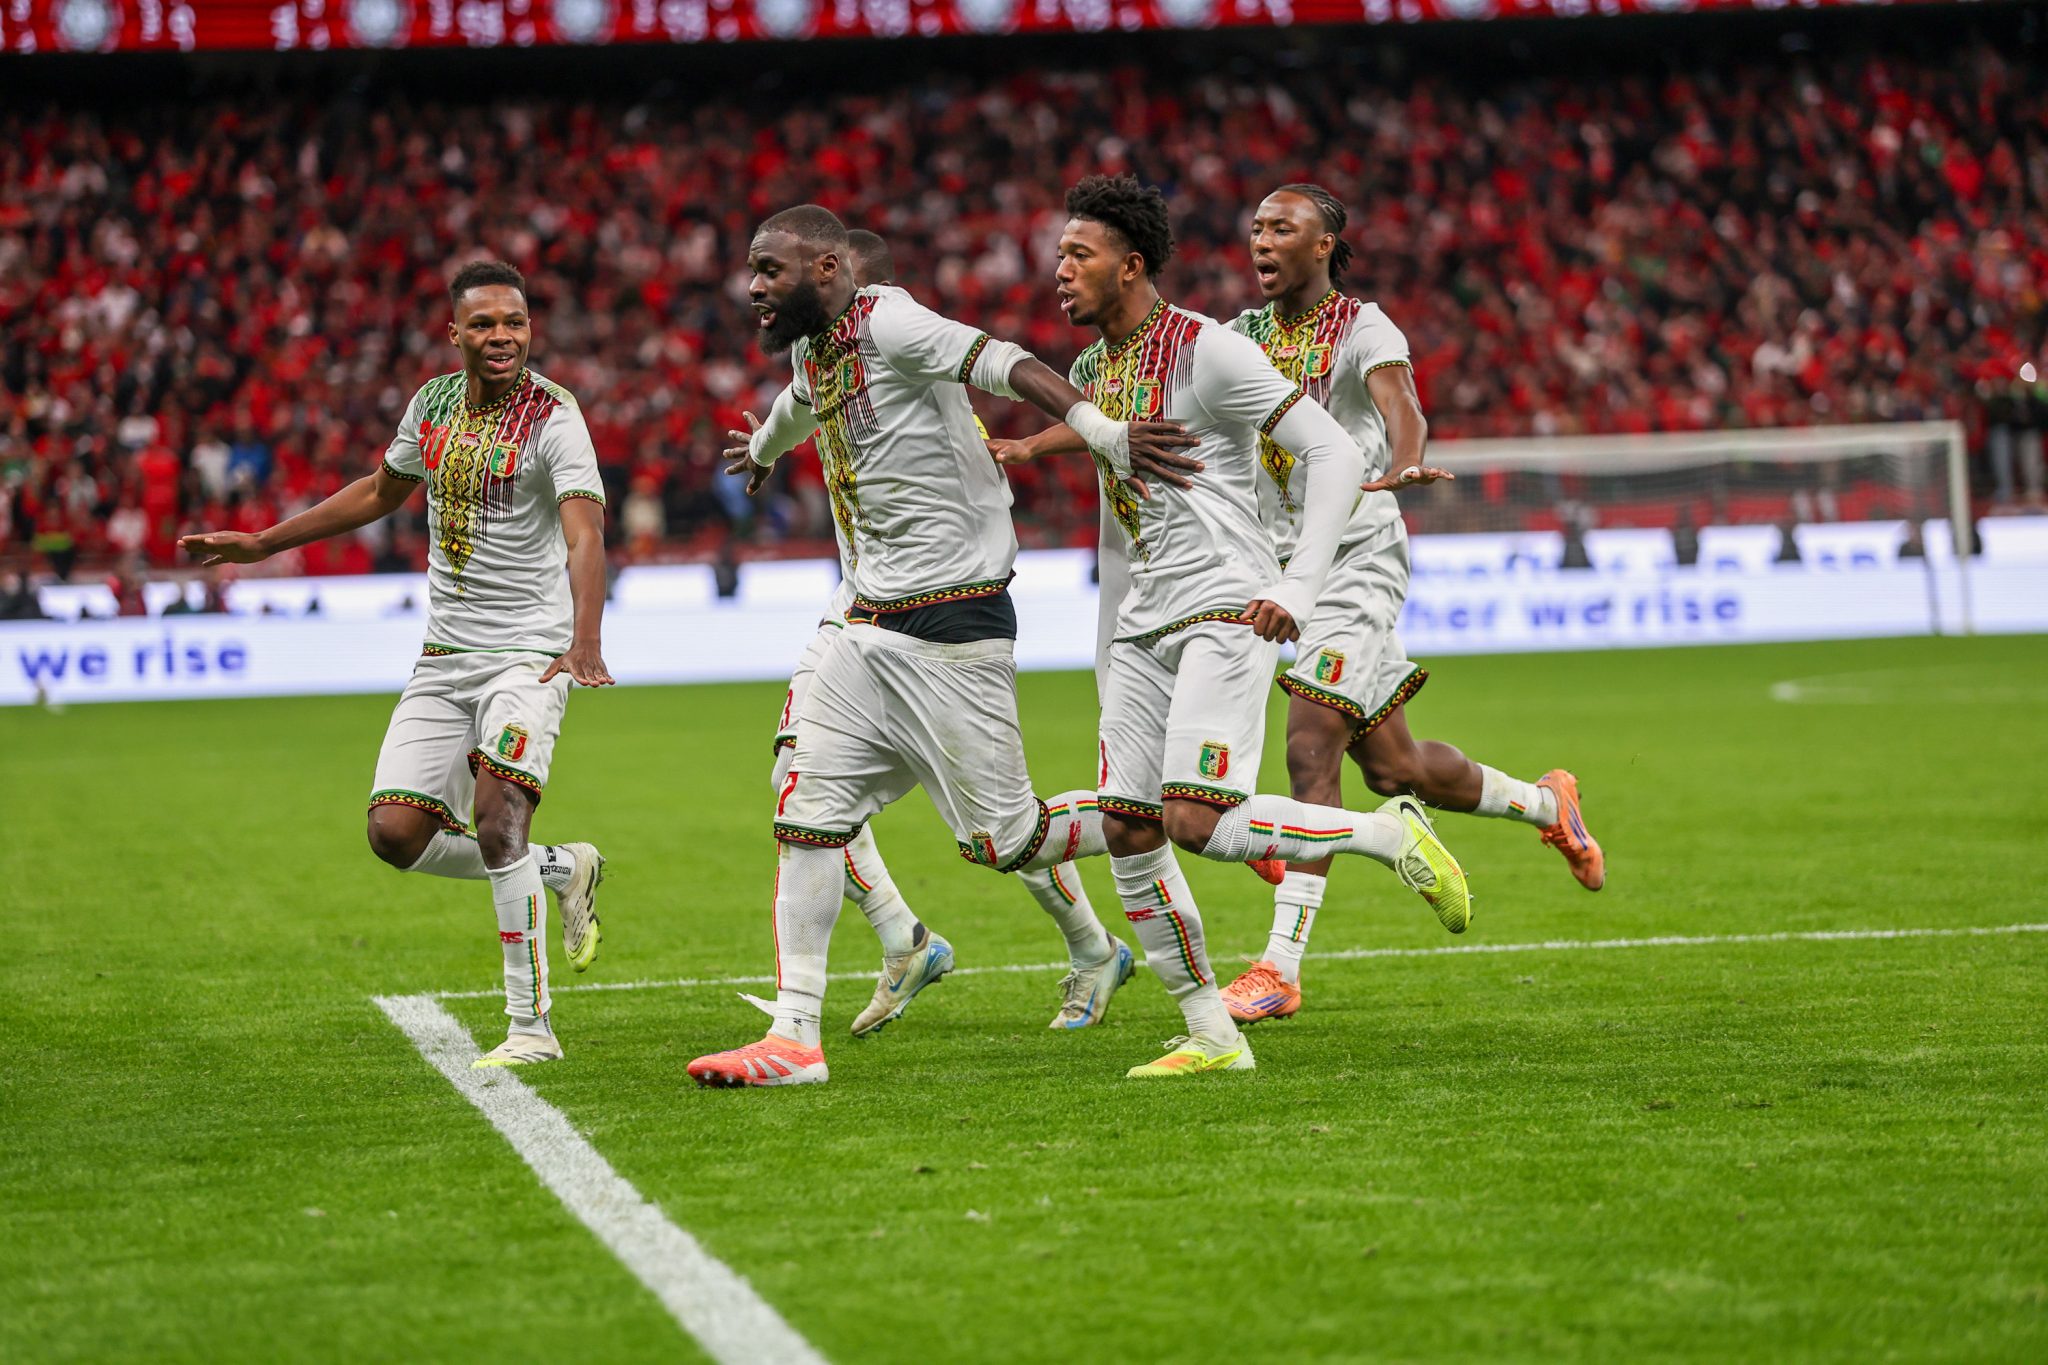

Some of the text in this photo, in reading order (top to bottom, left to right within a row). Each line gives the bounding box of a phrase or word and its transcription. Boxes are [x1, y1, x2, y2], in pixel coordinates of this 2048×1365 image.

[418, 420, 450, 471] 20
[1632, 587, 1739, 624] rise
[17, 628, 248, 680] we rise
